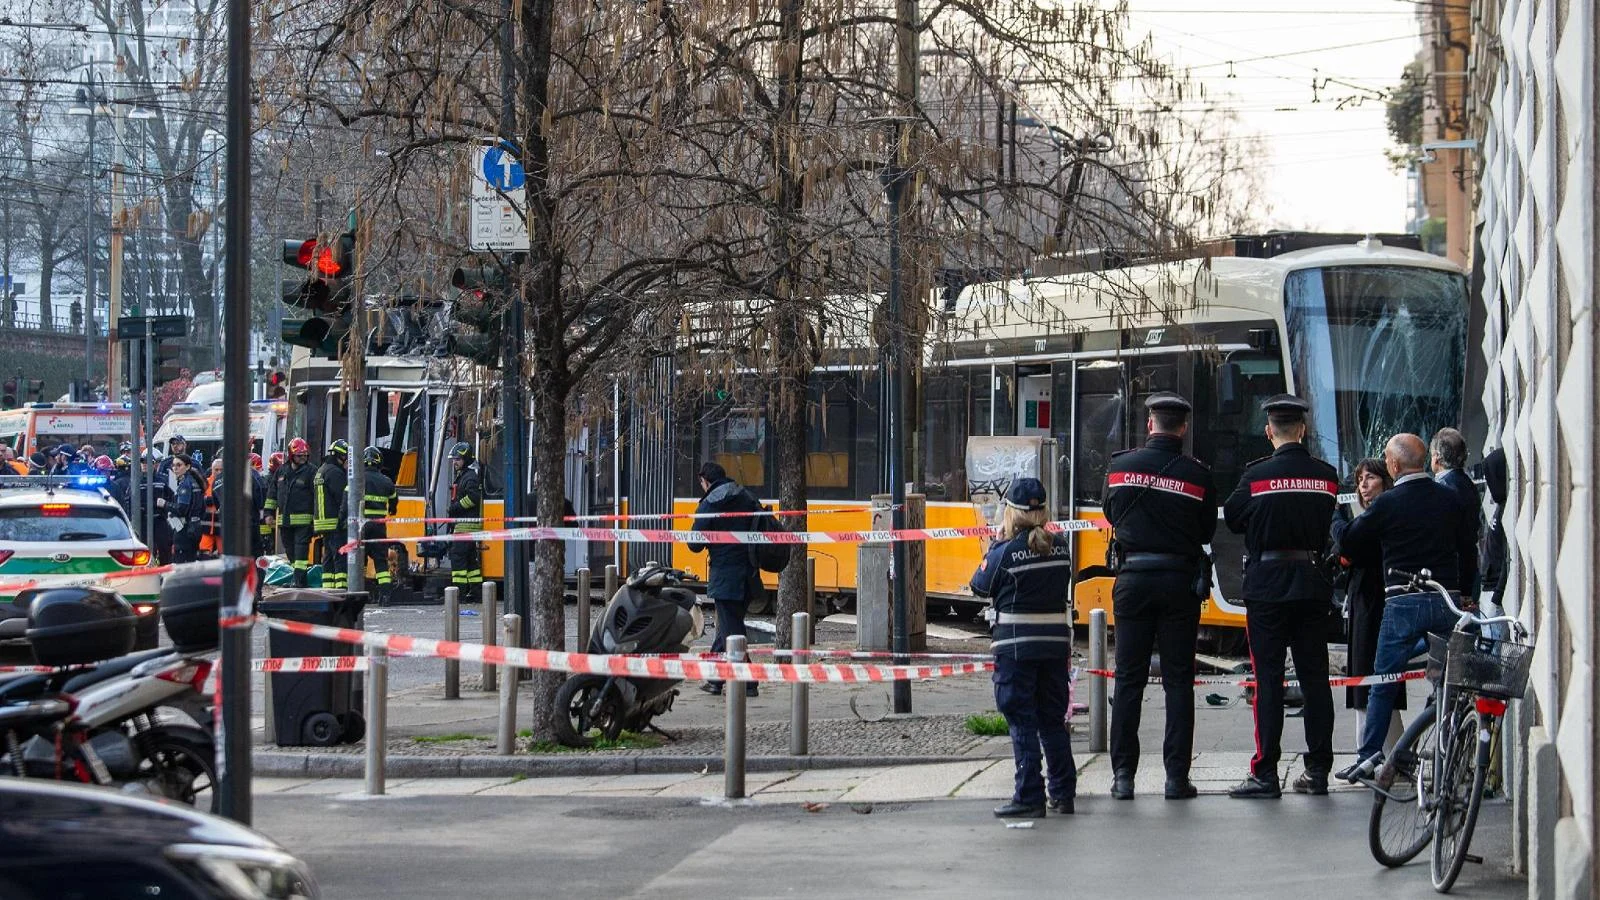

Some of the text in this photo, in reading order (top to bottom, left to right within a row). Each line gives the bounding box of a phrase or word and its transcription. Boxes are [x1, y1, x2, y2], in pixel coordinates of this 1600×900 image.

[1124, 473, 1185, 492] CARABINIERI
[1269, 478, 1328, 491] CARABINIERI
[329, 656, 355, 667] POLIZIA
